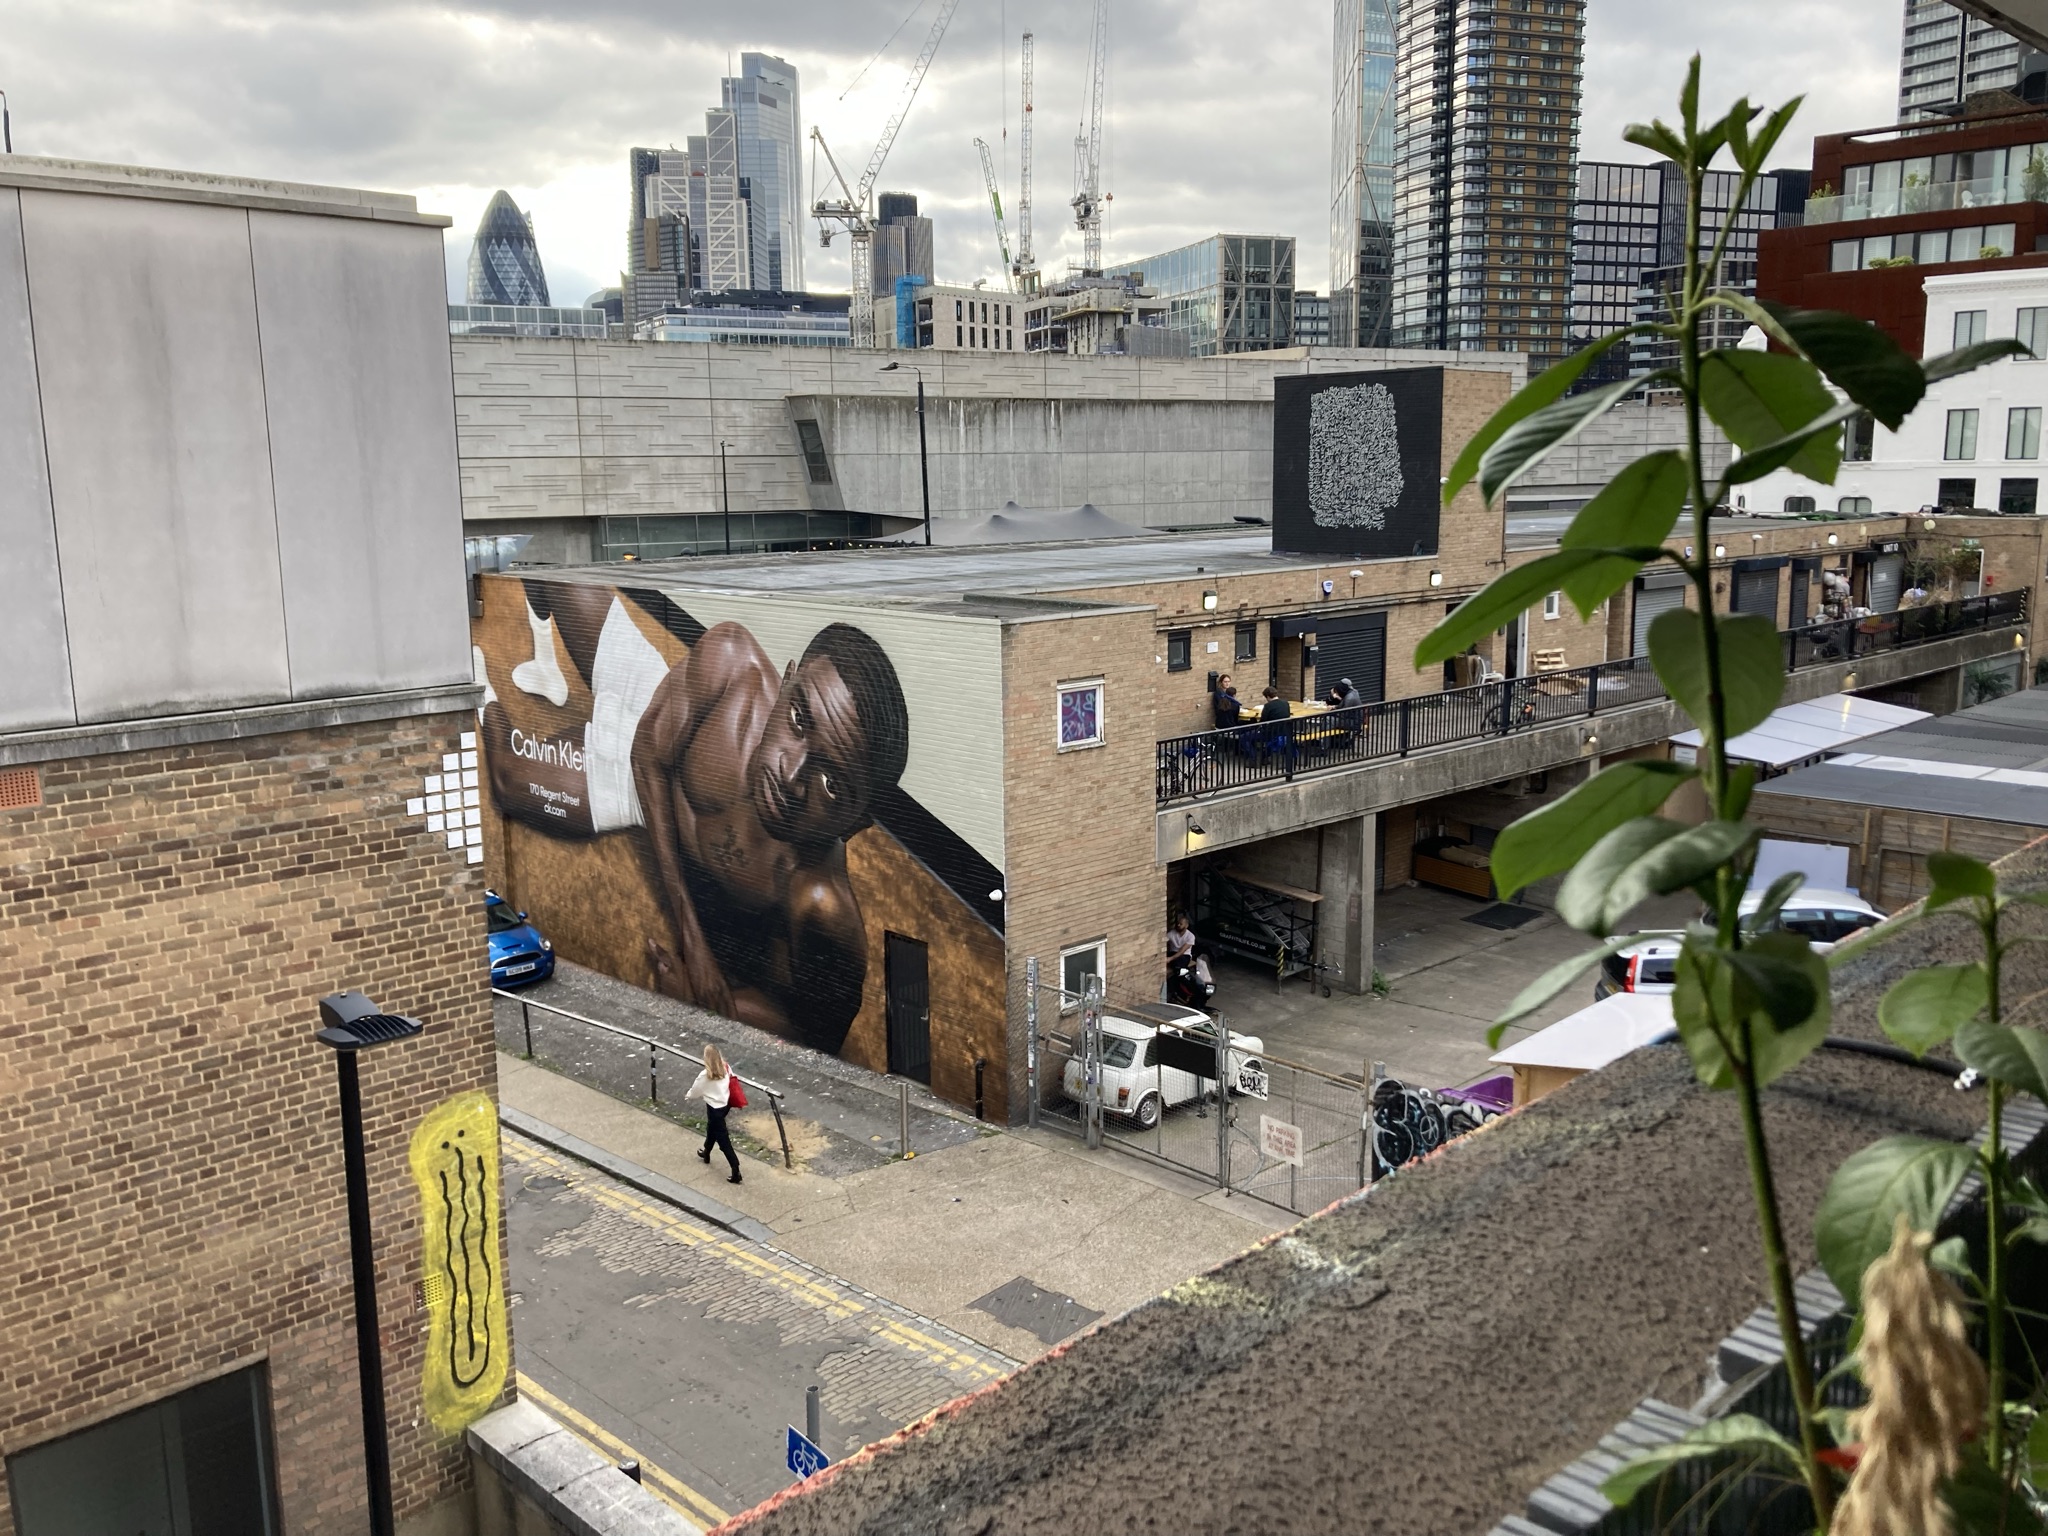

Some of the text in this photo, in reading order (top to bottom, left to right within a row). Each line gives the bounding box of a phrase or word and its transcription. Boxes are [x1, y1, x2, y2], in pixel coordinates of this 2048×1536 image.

[1883, 543, 1899, 553] UNIT 10
[511, 728, 557, 766] Calvin
[529, 782, 580, 807] 170 Regent Street
[543, 802, 567, 818] ck.com
[1267, 1124, 1296, 1140] NO PARKING
[1284, 1138, 1296, 1149] AREA
[1285, 1148, 1296, 1158] TIME
